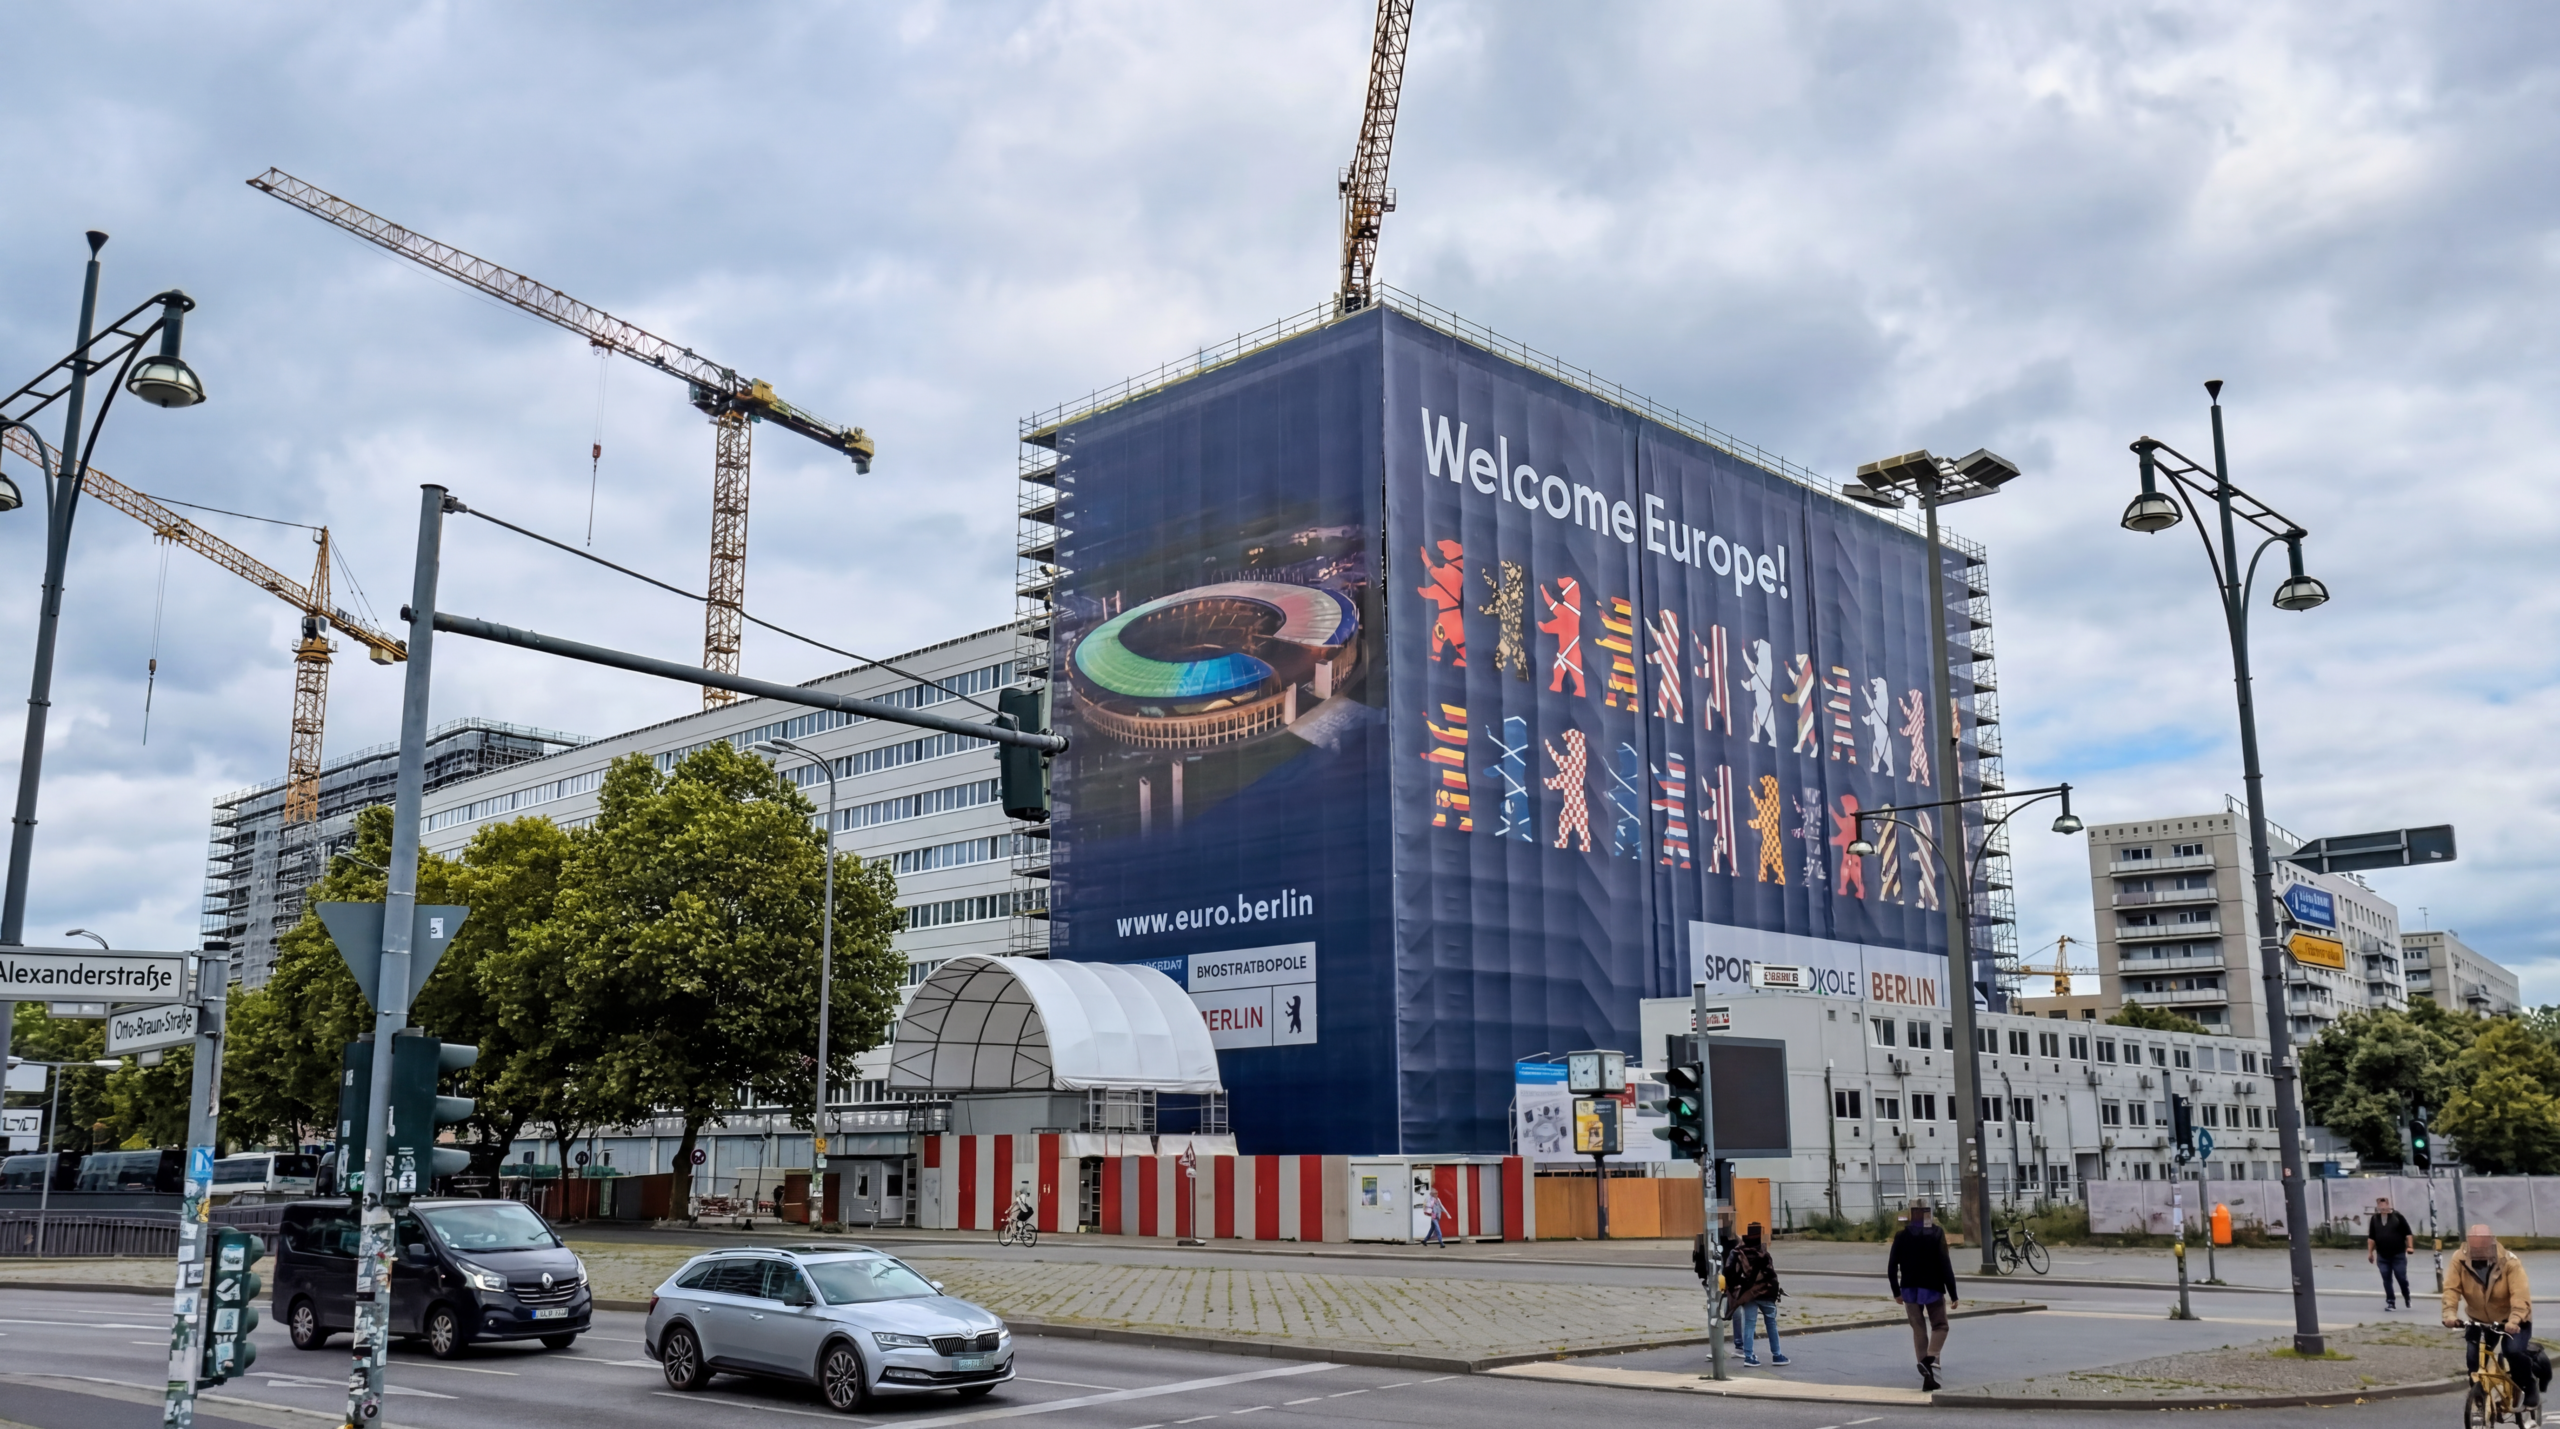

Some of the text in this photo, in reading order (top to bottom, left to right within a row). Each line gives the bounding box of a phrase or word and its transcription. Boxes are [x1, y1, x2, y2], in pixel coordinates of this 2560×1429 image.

[1421, 406, 1789, 599] Welcome Europe!
[1116, 888, 1313, 938] www.euro.berlin
[0, 960, 172, 992] Alexanderstraße
[1871, 971, 1936, 1007] BERLIN
[115, 1008, 192, 1040] Otto-Braun-Straße
